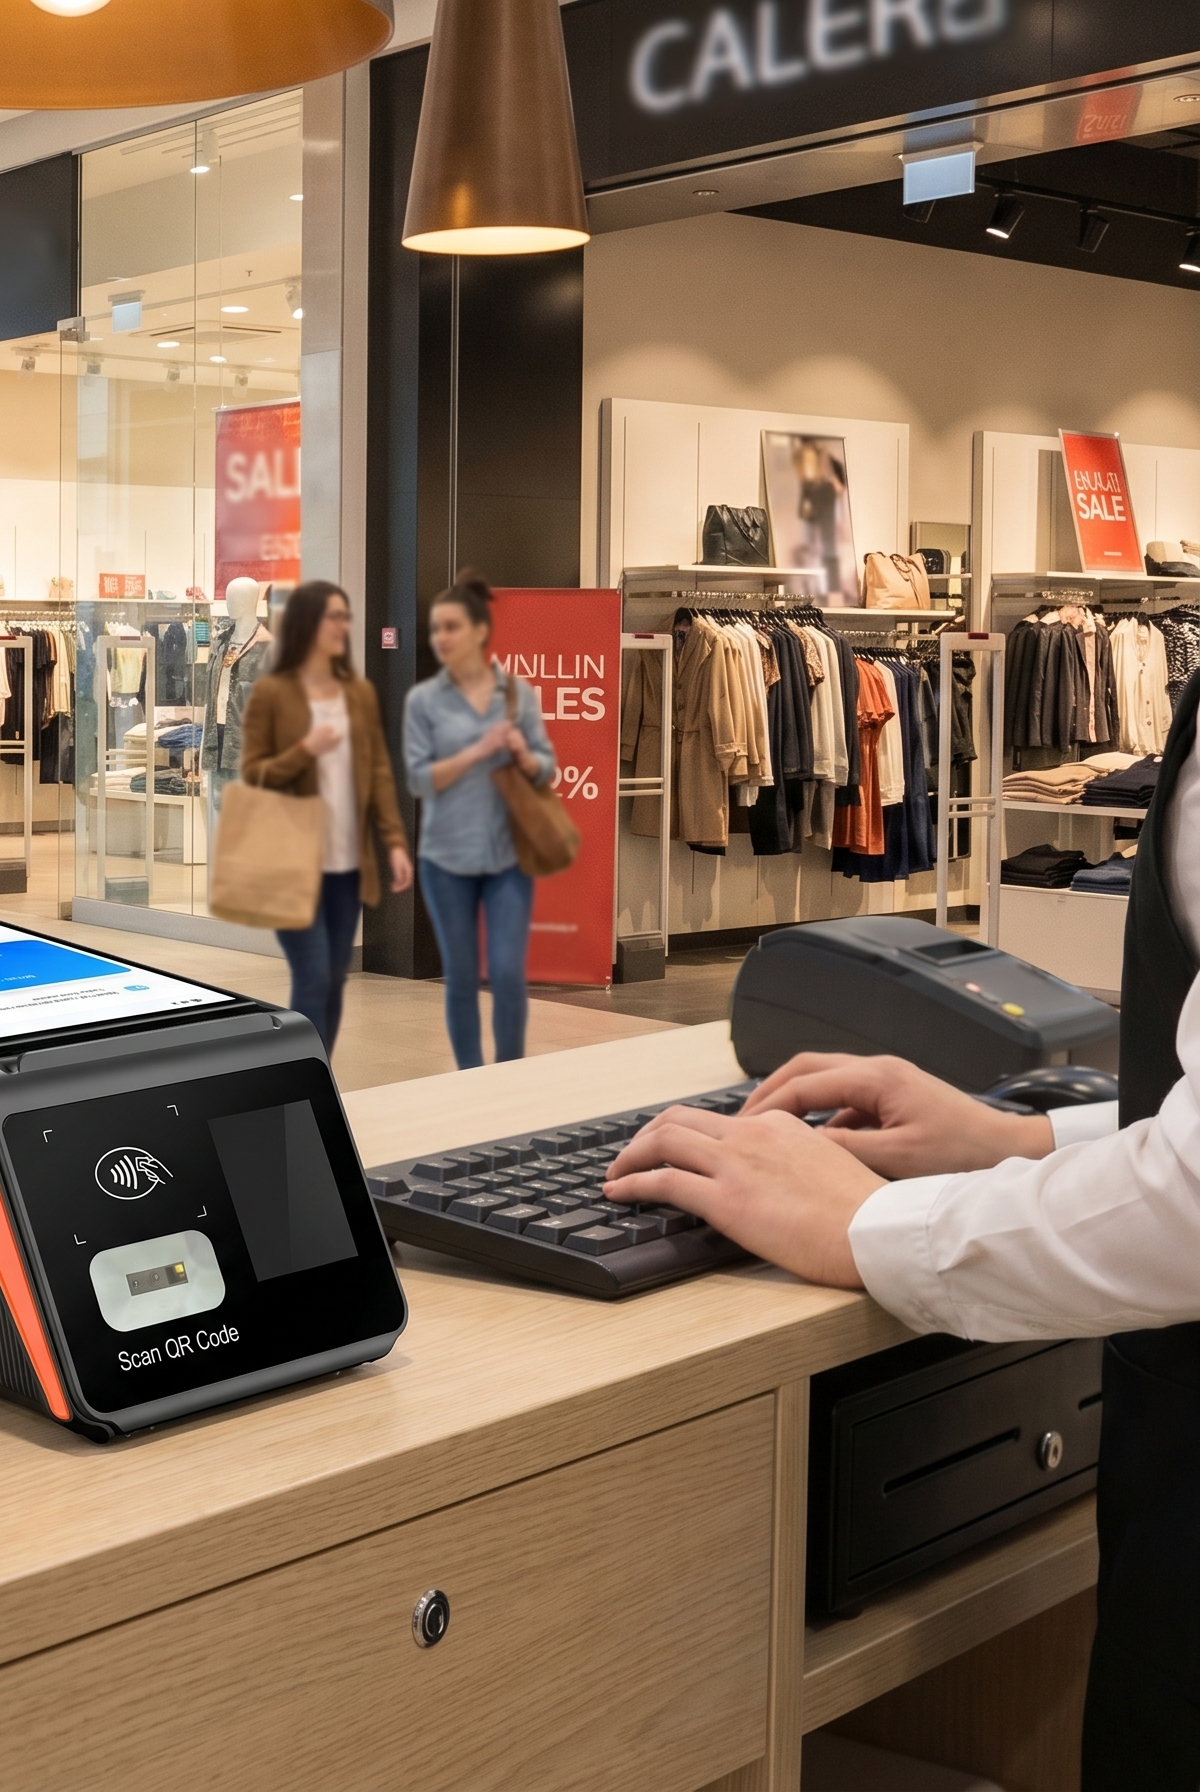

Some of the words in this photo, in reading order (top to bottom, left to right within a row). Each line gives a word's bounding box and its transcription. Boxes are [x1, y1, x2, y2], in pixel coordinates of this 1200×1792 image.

[225, 447, 301, 503] SAL
[1076, 493, 1127, 522] SALE
[534, 685, 606, 722] LES
[118, 1347, 162, 1371] Scan
[165, 1335, 194, 1359] QR
[196, 1324, 240, 1350] Code
